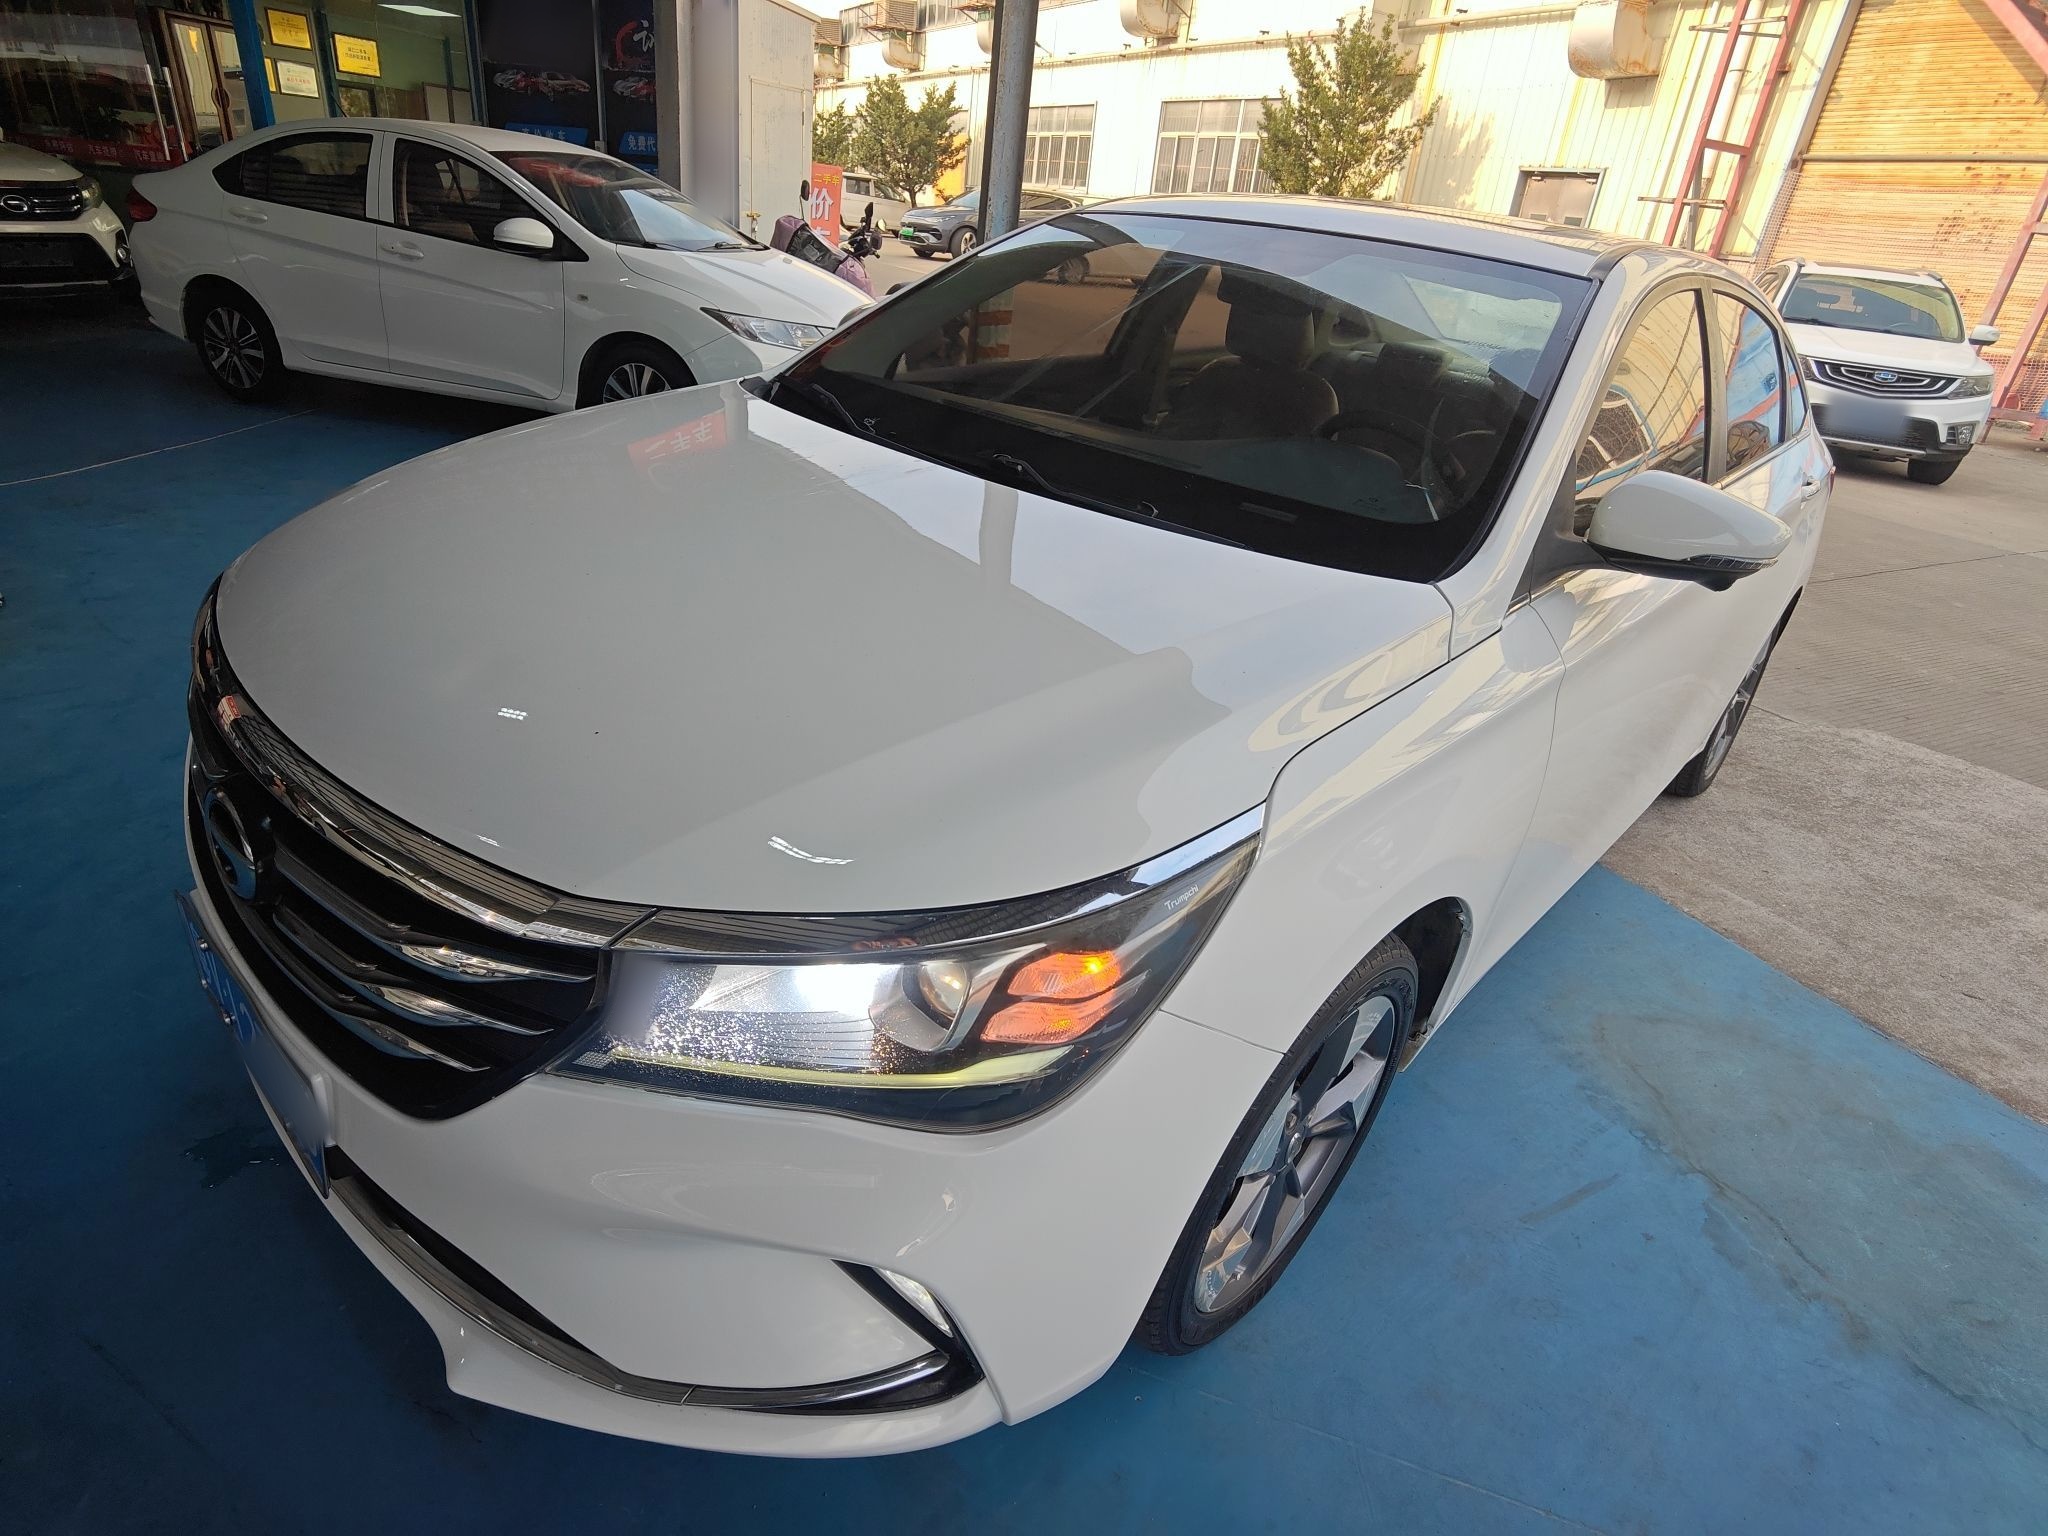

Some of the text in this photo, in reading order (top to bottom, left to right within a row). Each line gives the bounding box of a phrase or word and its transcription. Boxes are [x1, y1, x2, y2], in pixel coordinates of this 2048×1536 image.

[628, 134, 656, 151] 免费代
[813, 173, 840, 187] 二手车
[1164, 884, 1199, 910] Trumpchi
